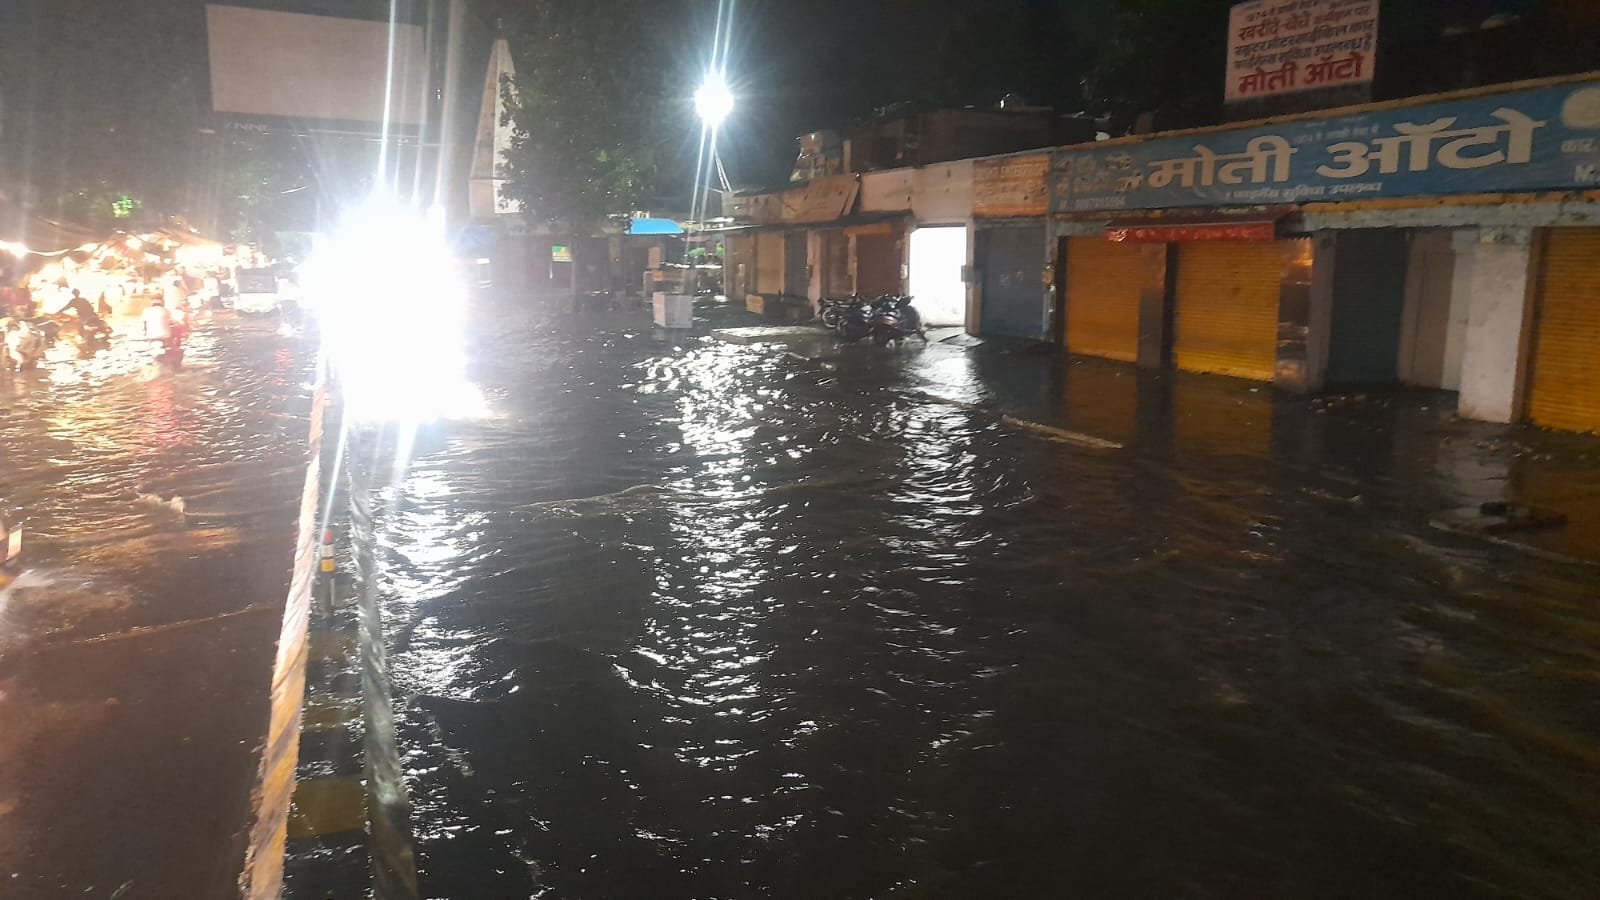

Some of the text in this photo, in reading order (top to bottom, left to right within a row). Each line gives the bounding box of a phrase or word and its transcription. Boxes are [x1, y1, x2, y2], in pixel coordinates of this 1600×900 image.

[1239, 52, 1366, 93] मोती ऑटो
[1146, 107, 1547, 190] मोती ऑटो
